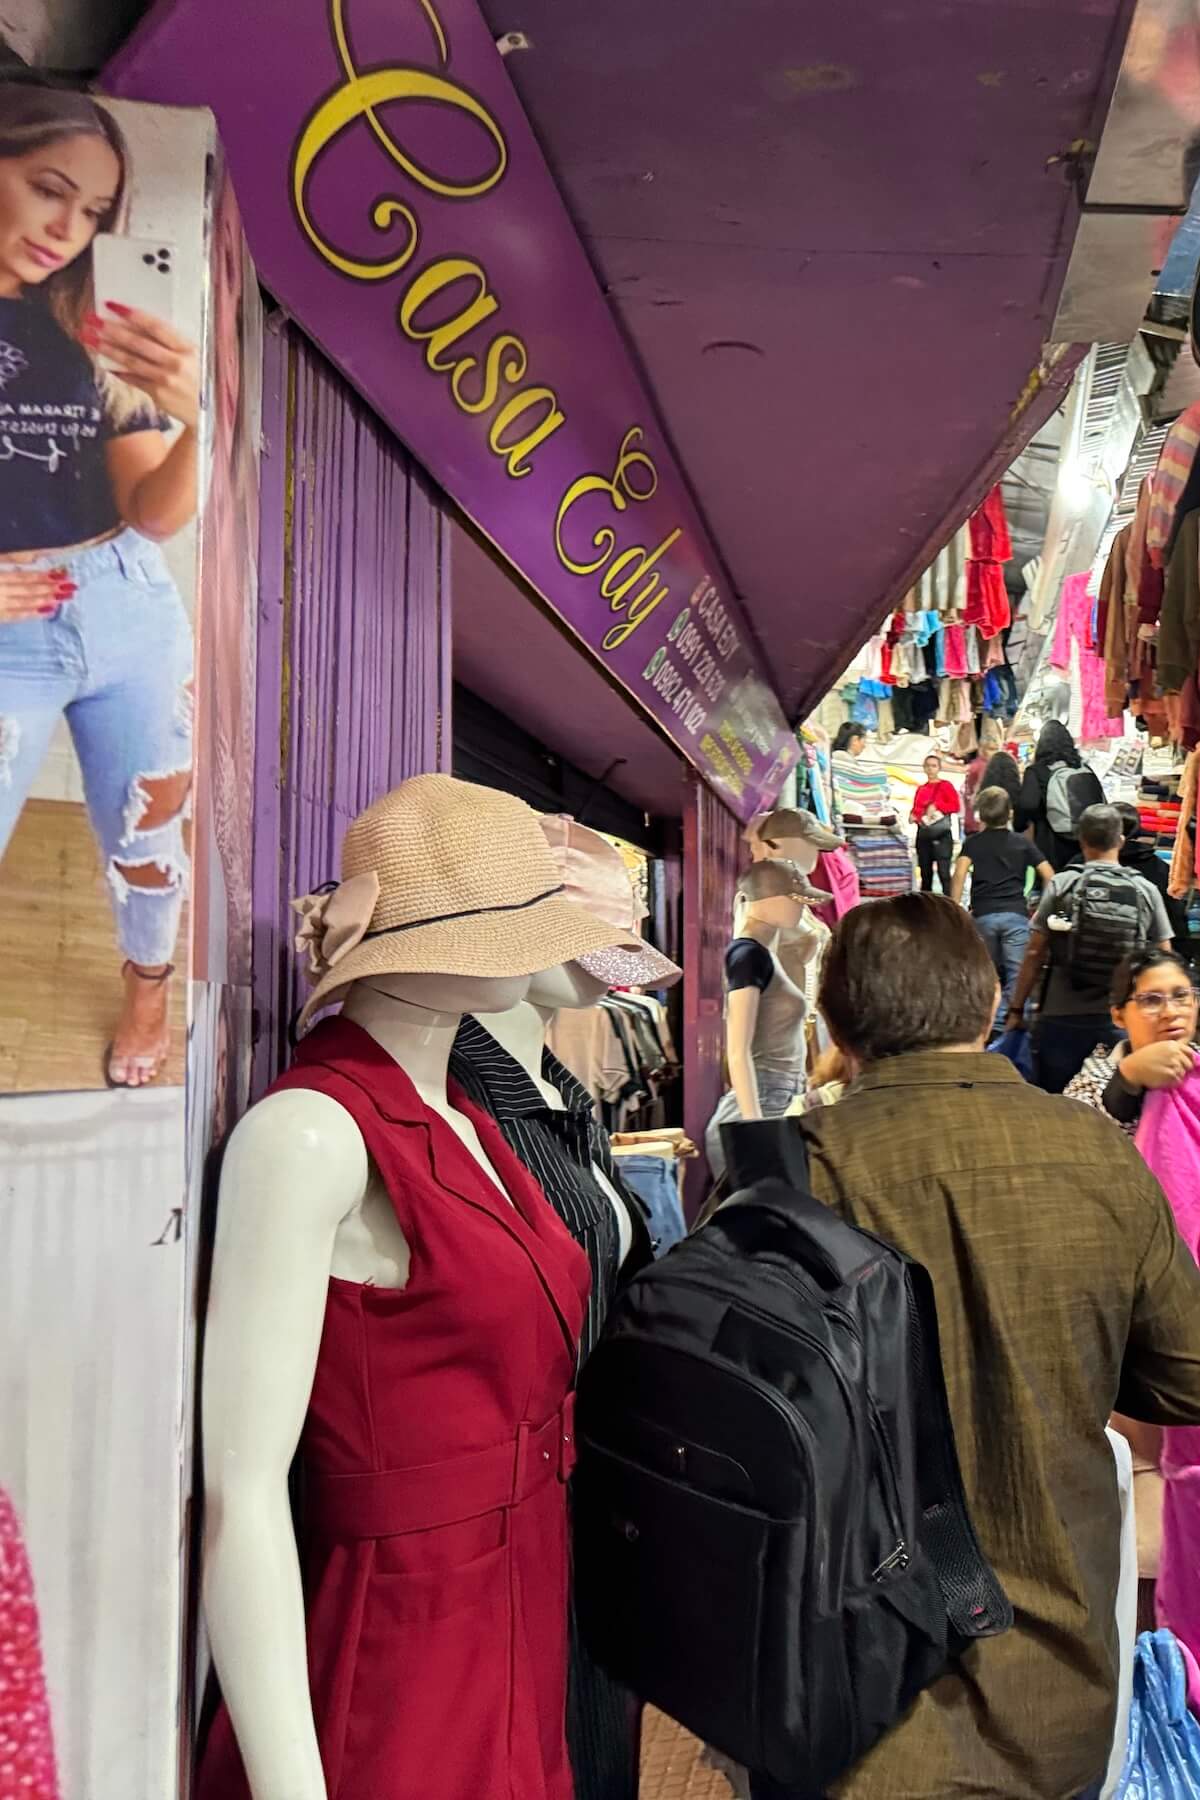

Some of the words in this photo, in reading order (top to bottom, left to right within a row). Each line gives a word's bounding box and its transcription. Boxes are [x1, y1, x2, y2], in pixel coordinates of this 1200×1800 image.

[293, 0, 566, 477] Casa
[554, 427, 682, 650] Edy
[676, 622, 704, 666] 0991
[698, 586, 728, 642] CASA
[716, 624, 741, 662] EDY
[652, 660, 683, 704] 0982
